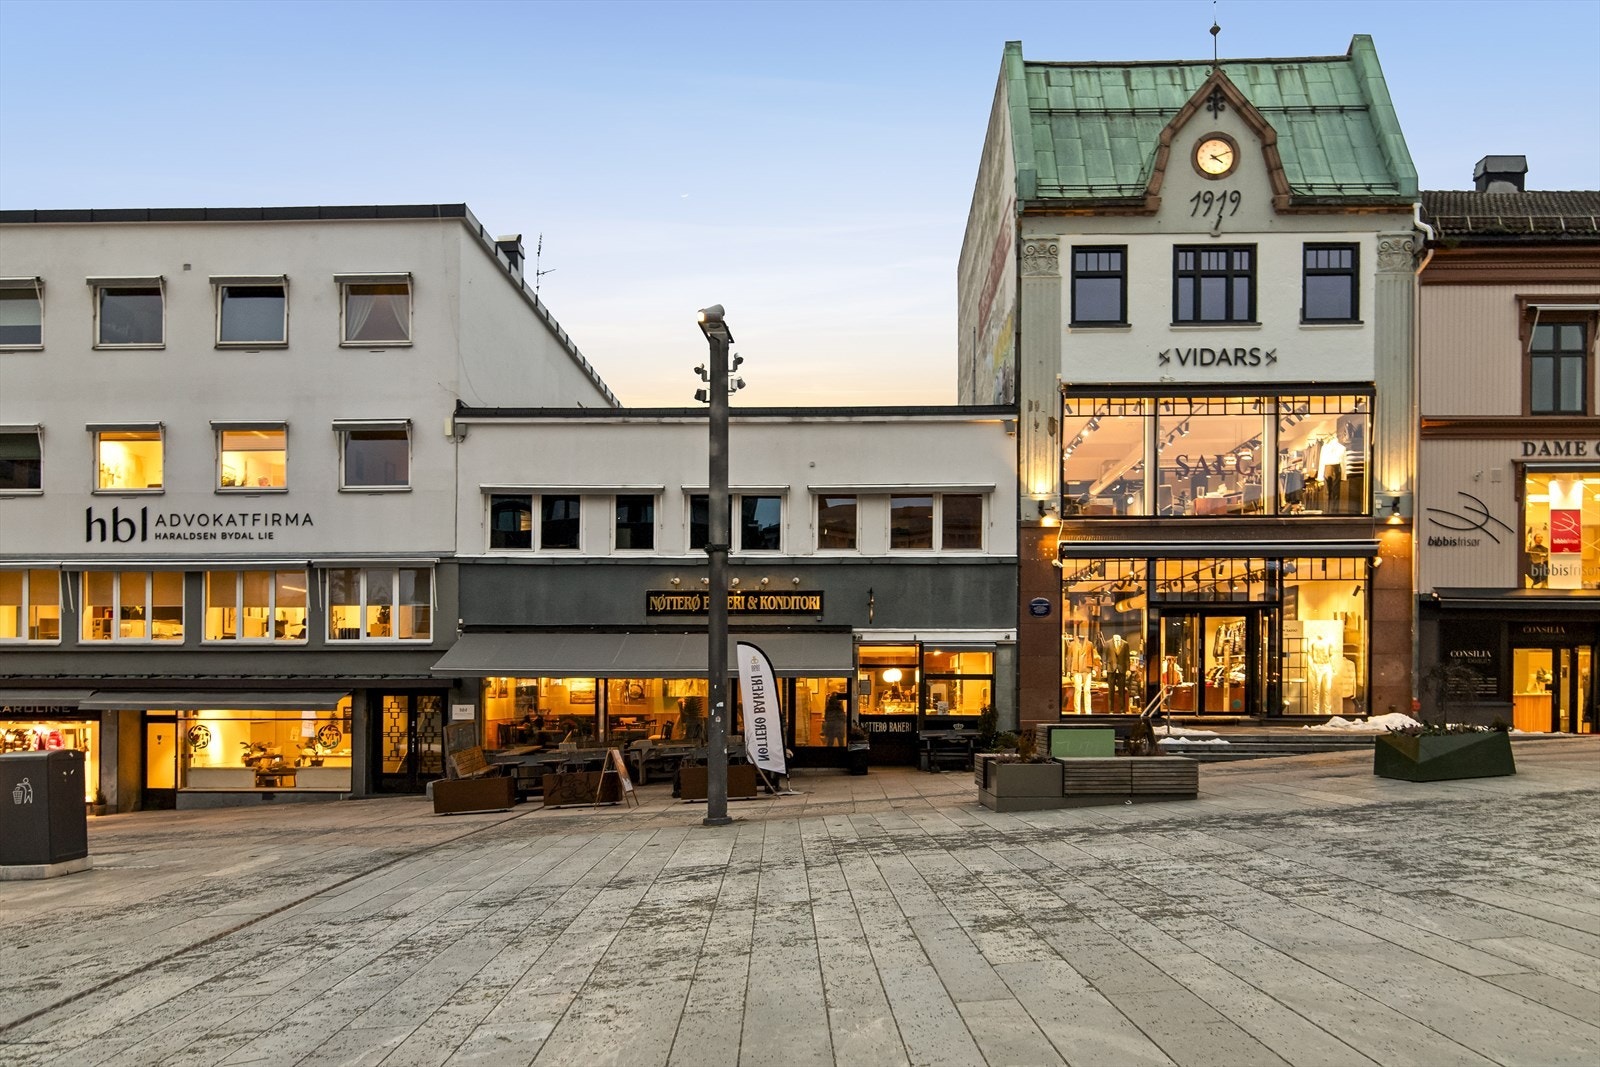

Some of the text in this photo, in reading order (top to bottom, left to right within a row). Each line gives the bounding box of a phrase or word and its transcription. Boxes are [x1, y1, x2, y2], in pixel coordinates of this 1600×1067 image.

[1190, 190, 1241, 217] 1919
[1175, 348, 1261, 366] VIDARS
[1521, 441, 1587, 456] DAME
[1175, 454, 1255, 476] SALG
[86, 506, 148, 543] hbl
[155, 513, 314, 527] ADVOKATFIRMA
[155, 532, 274, 540] HARALDSEN BYDAL LIE
[649, 594, 820, 612] NØTTERØ BERI & KONDITORI
[1523, 626, 1566, 634] CONSILIA
[1450, 650, 1492, 658] CONSILIA
[0, 704, 71, 713] AROLINE
